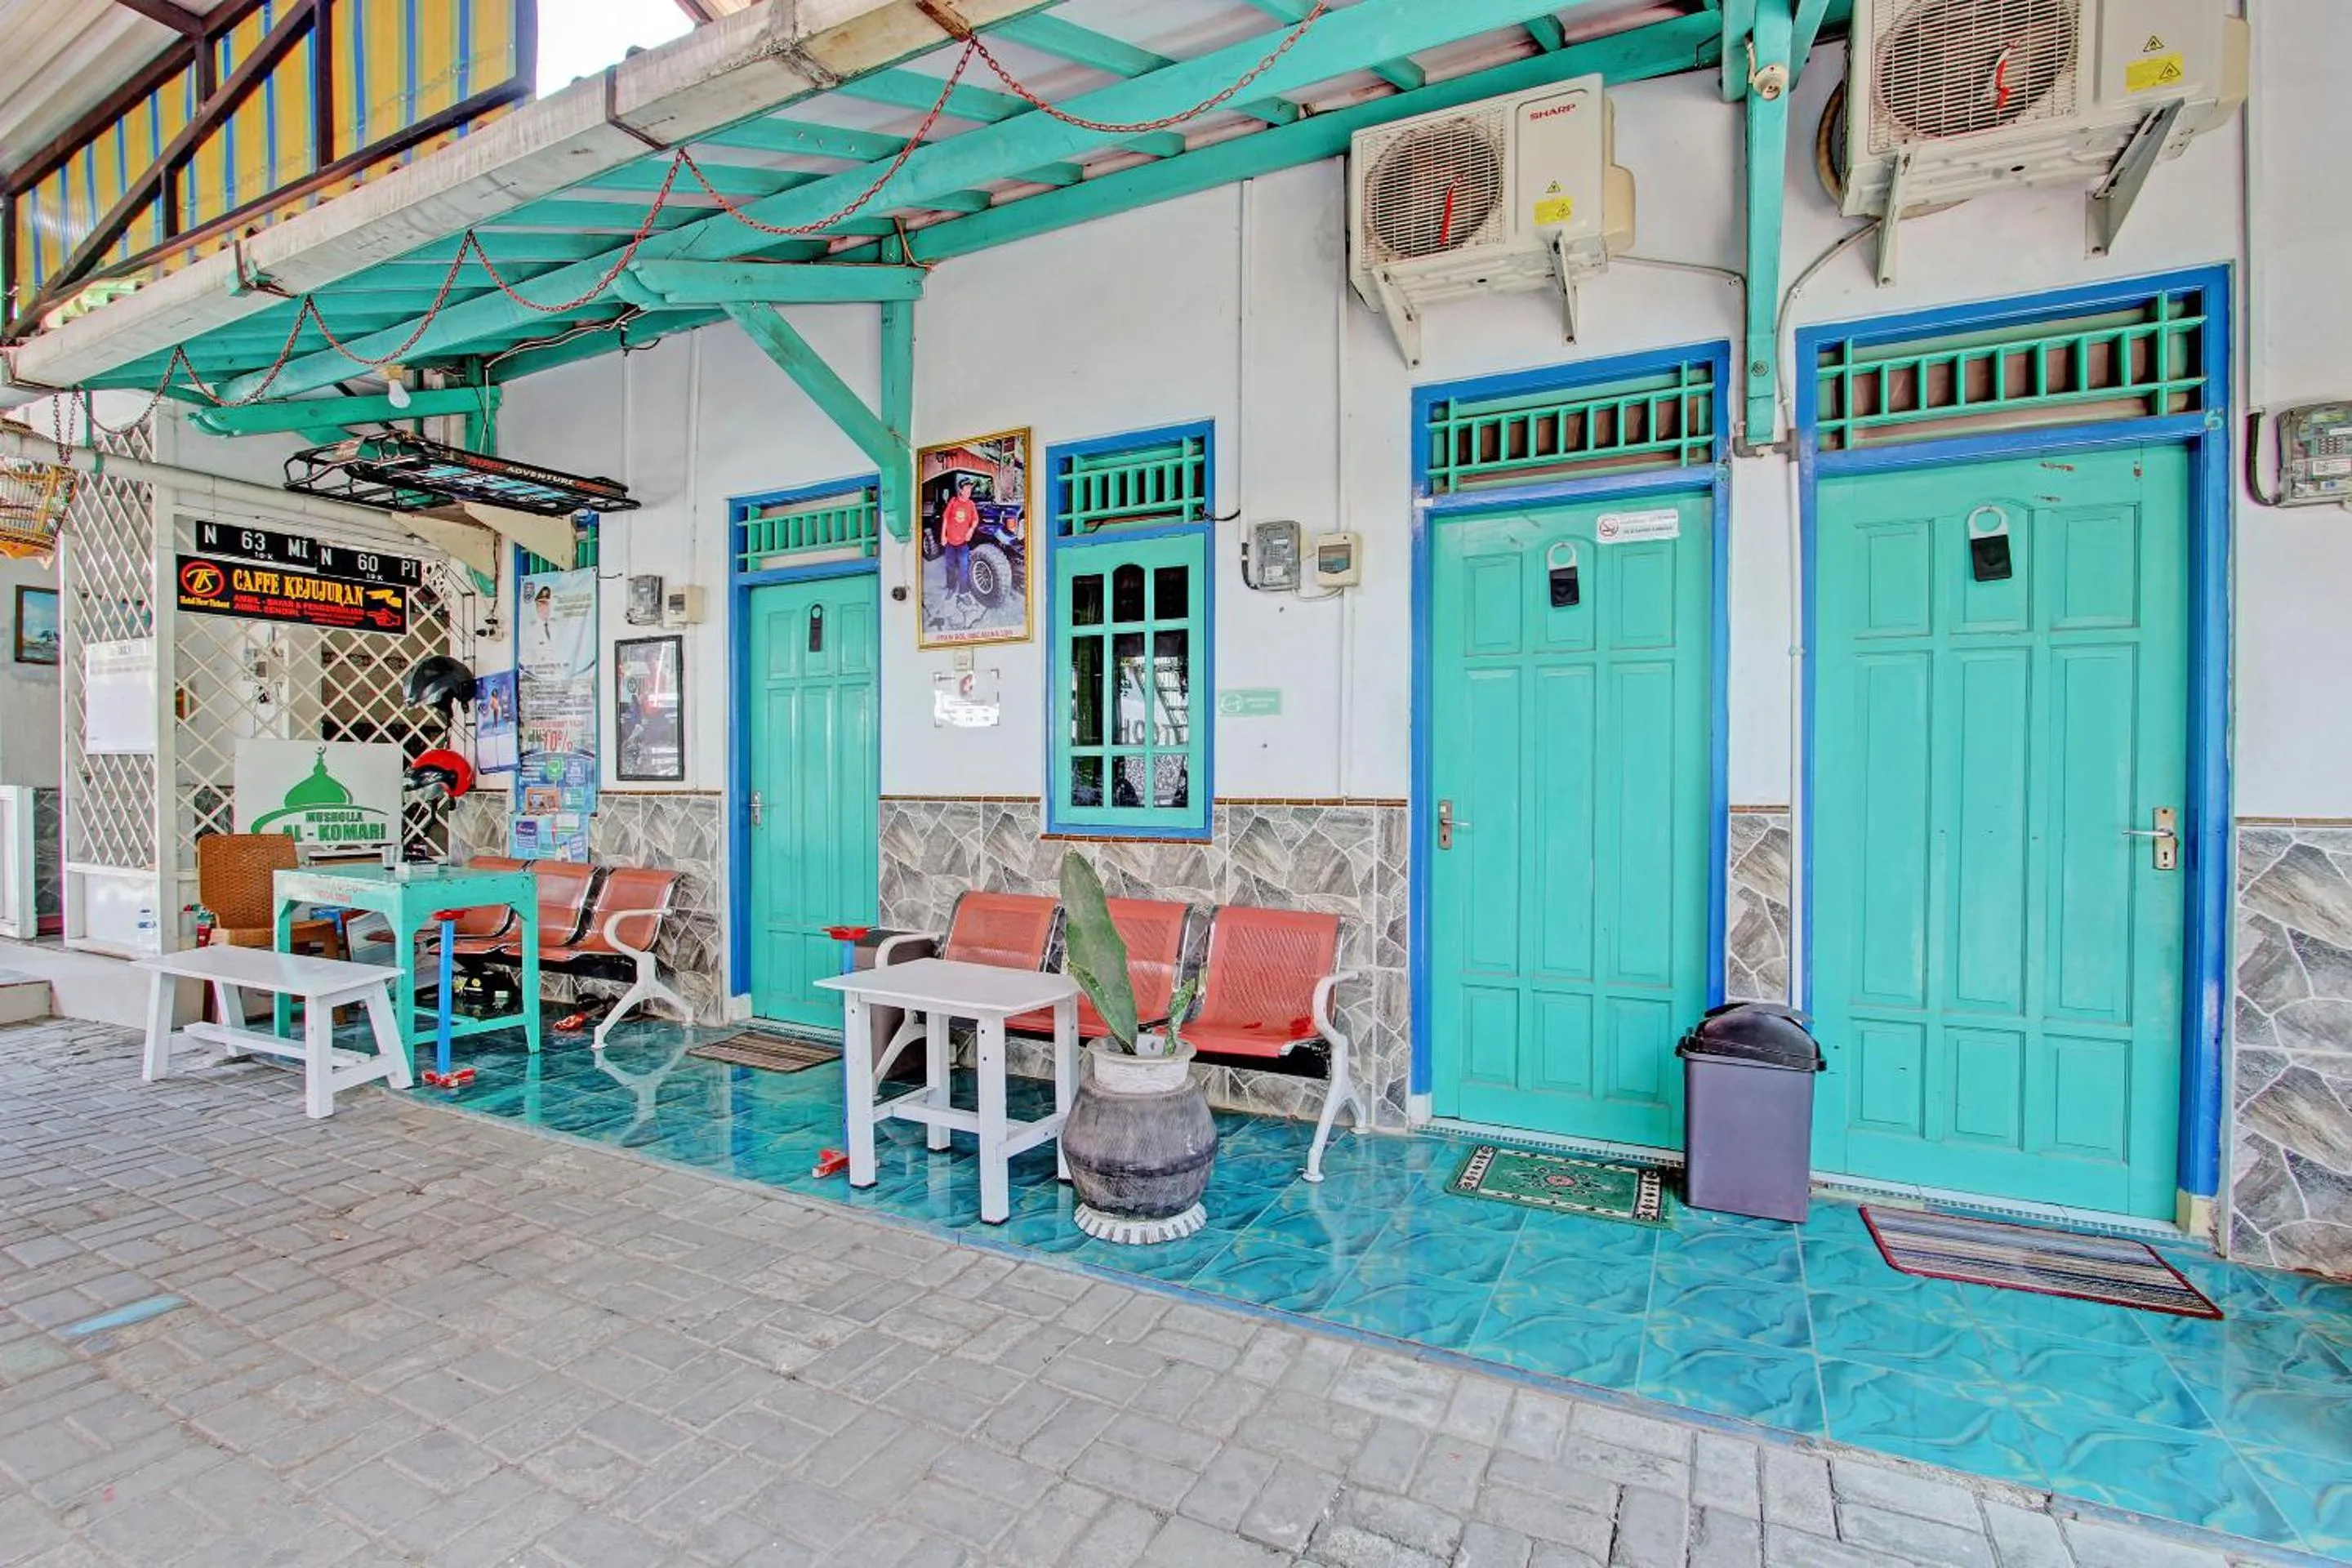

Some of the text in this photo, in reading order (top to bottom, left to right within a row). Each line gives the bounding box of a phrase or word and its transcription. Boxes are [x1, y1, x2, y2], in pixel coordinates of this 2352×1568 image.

[1530, 103, 1576, 121] SHARP
[506, 466, 575, 486] ADVENTURE
[204, 524, 308, 559] N 63 MI
[320, 547, 417, 579] N 60 PI
[233, 568, 280, 595] CAFFE
[283, 575, 365, 607] KEJUJURAN
[305, 812, 363, 822] MUSHOLLA
[318, 823, 386, 841] KOMARI
